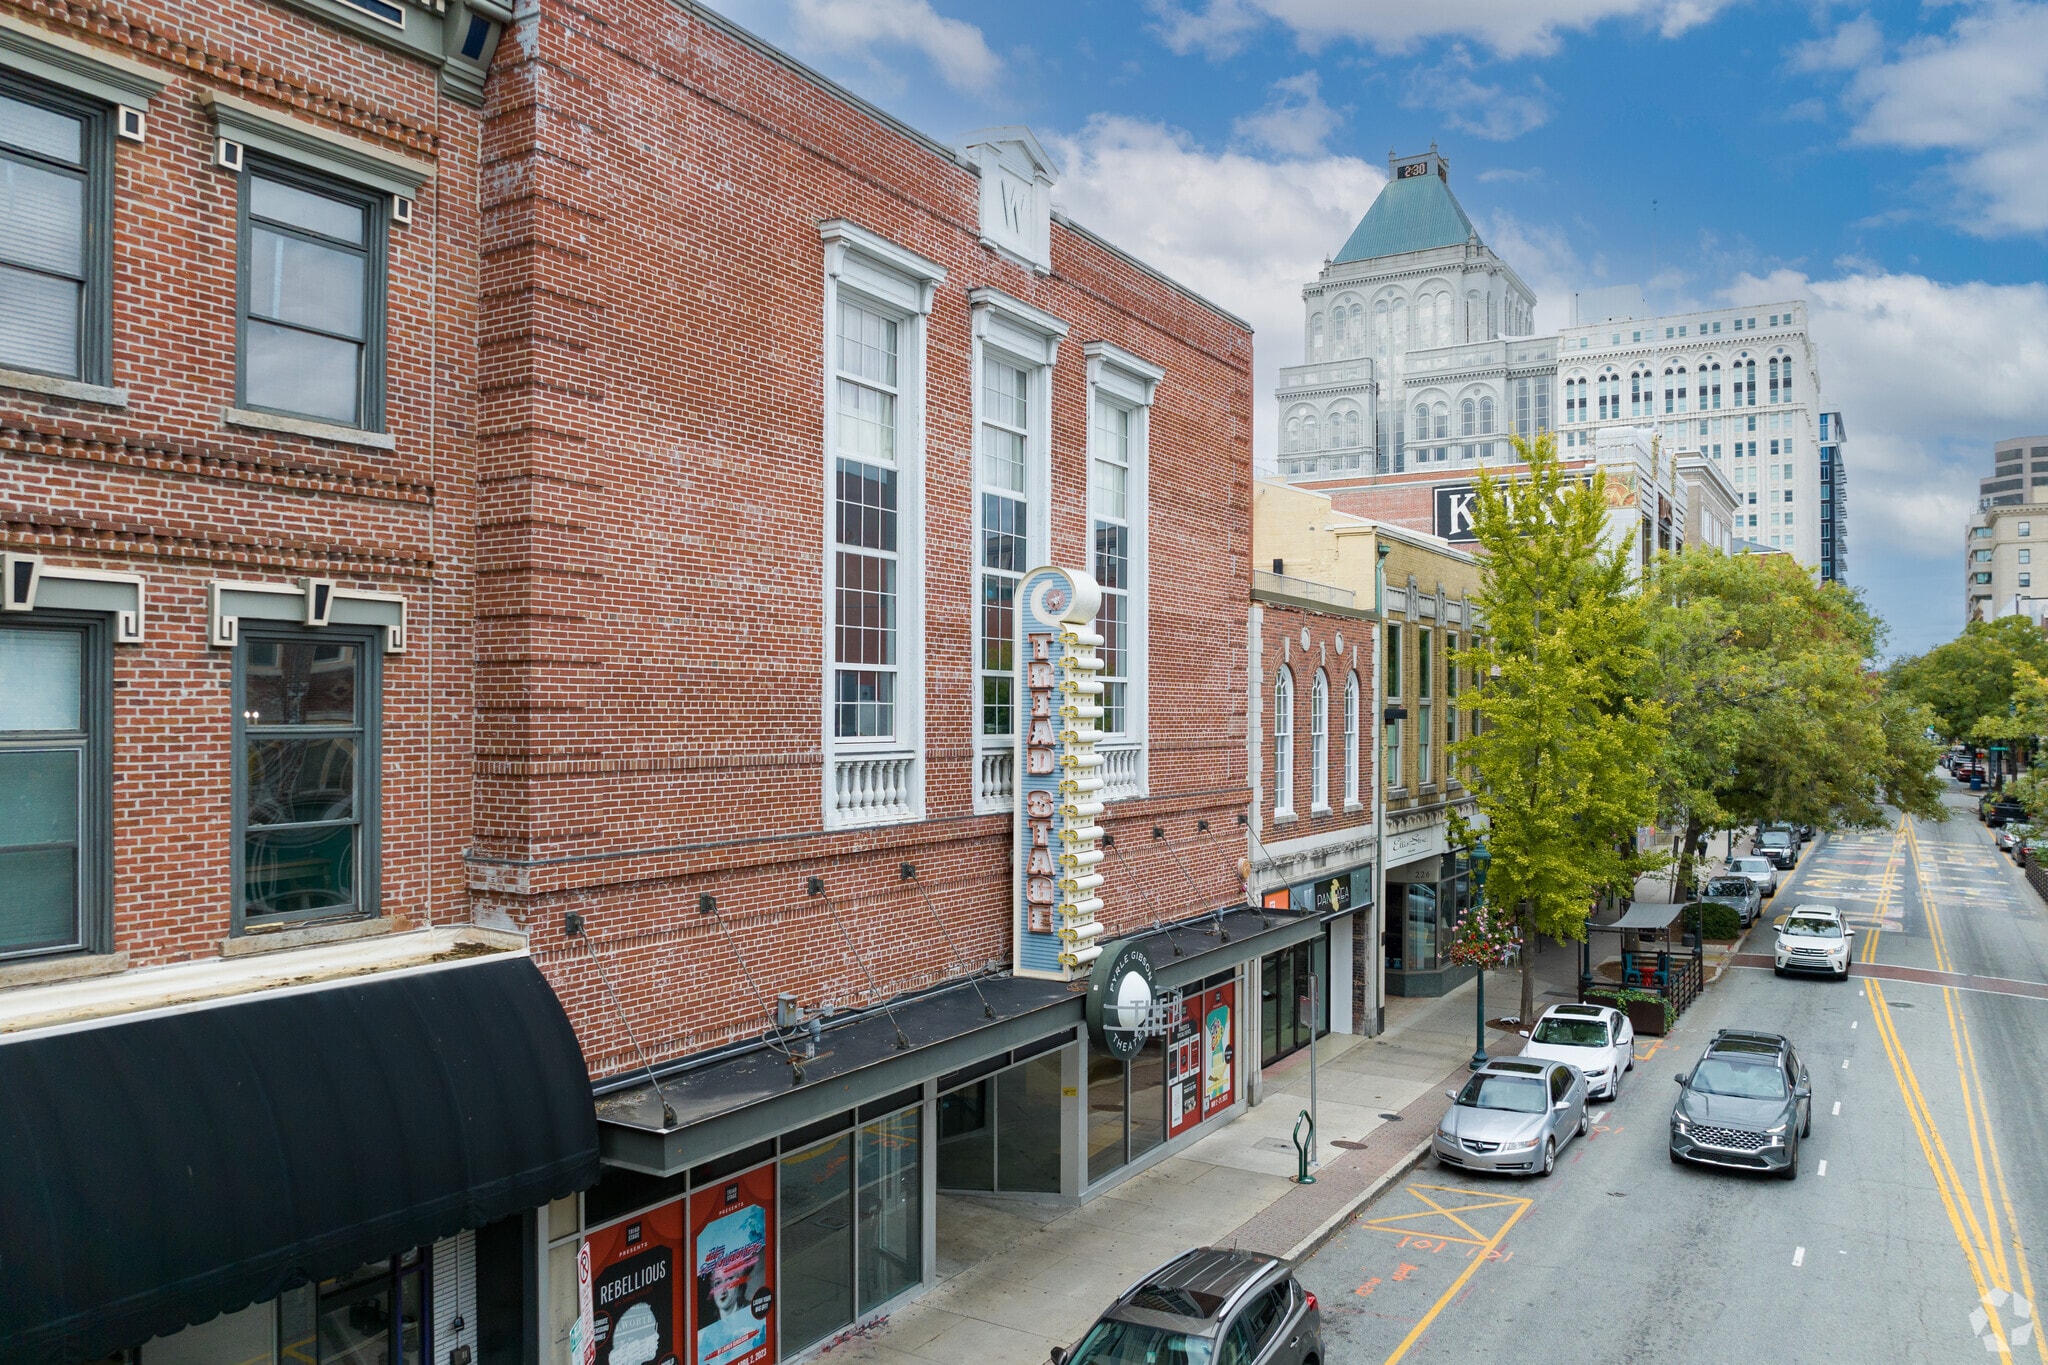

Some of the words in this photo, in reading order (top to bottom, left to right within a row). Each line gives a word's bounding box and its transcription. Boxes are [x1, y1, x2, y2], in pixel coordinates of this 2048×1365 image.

[1027, 632, 1056, 776] TRIAD
[1026, 789, 1056, 934] STAGE
[1415, 871, 1430, 879] 226
[1110, 953, 1129, 993] PYRLE
[1130, 951, 1153, 981] GIBSON
[719, 1201, 744, 1216] PRESENTS
[627, 1225, 640, 1235] TRIAD
[627, 1231, 640, 1241] STAGE
[618, 1242, 649, 1258] PRESENTS
[600, 1260, 666, 1306] REBELLIOUS
